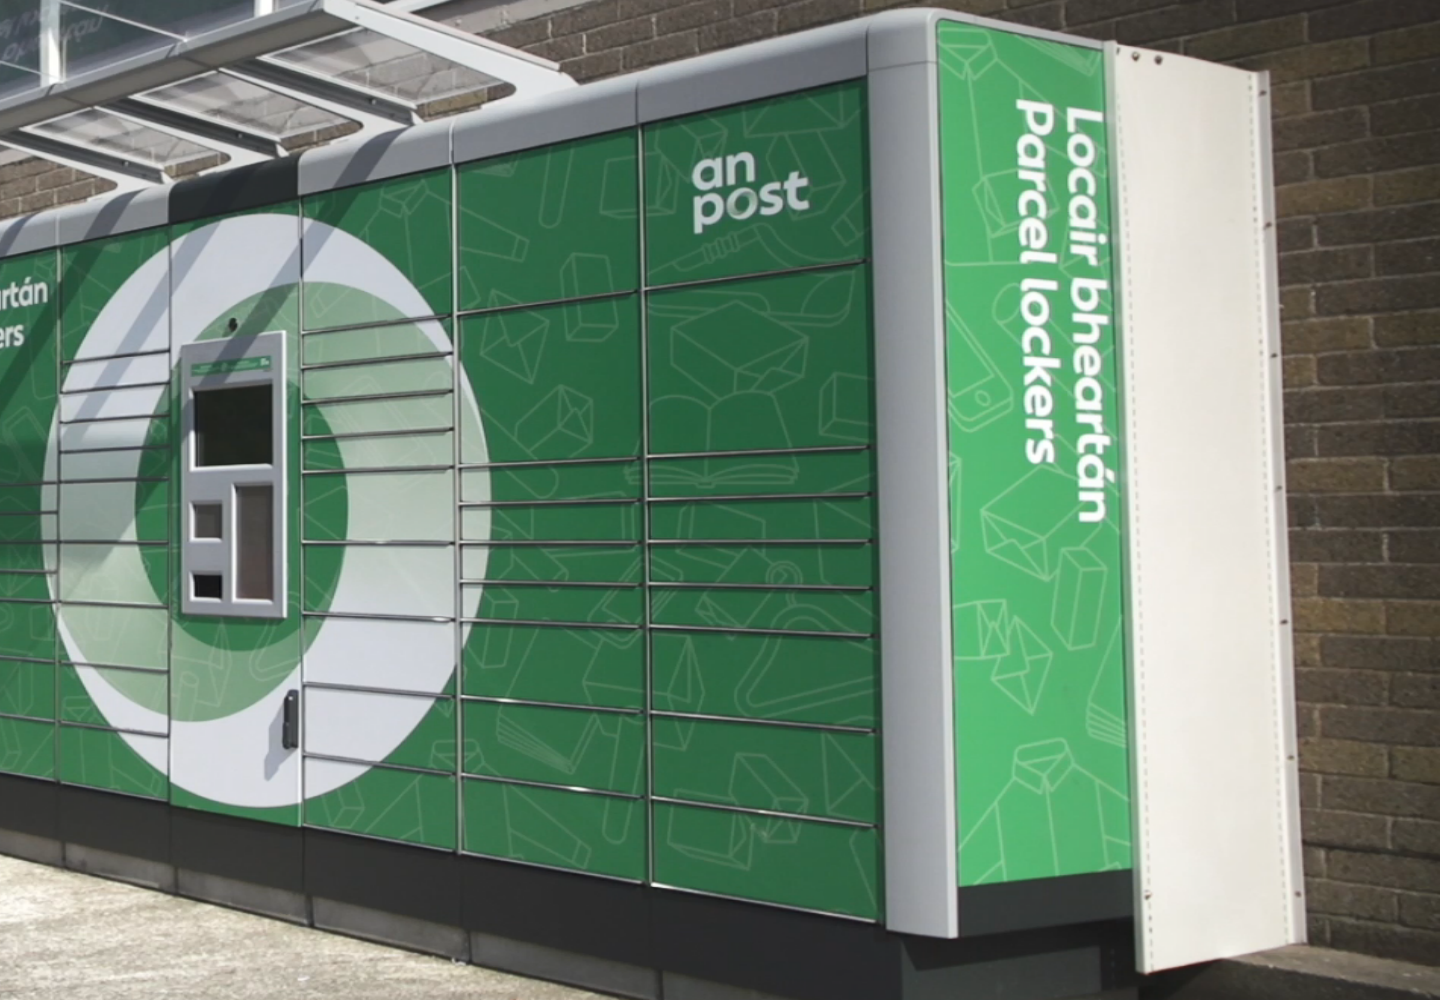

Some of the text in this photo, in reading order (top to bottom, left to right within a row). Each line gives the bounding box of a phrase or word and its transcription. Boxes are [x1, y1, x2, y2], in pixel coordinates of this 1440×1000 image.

[692, 151, 756, 191] an
[693, 171, 810, 234] post
[1016, 99, 1061, 464] Parcel lockers
[1066, 107, 1115, 522] Locair bheartán
